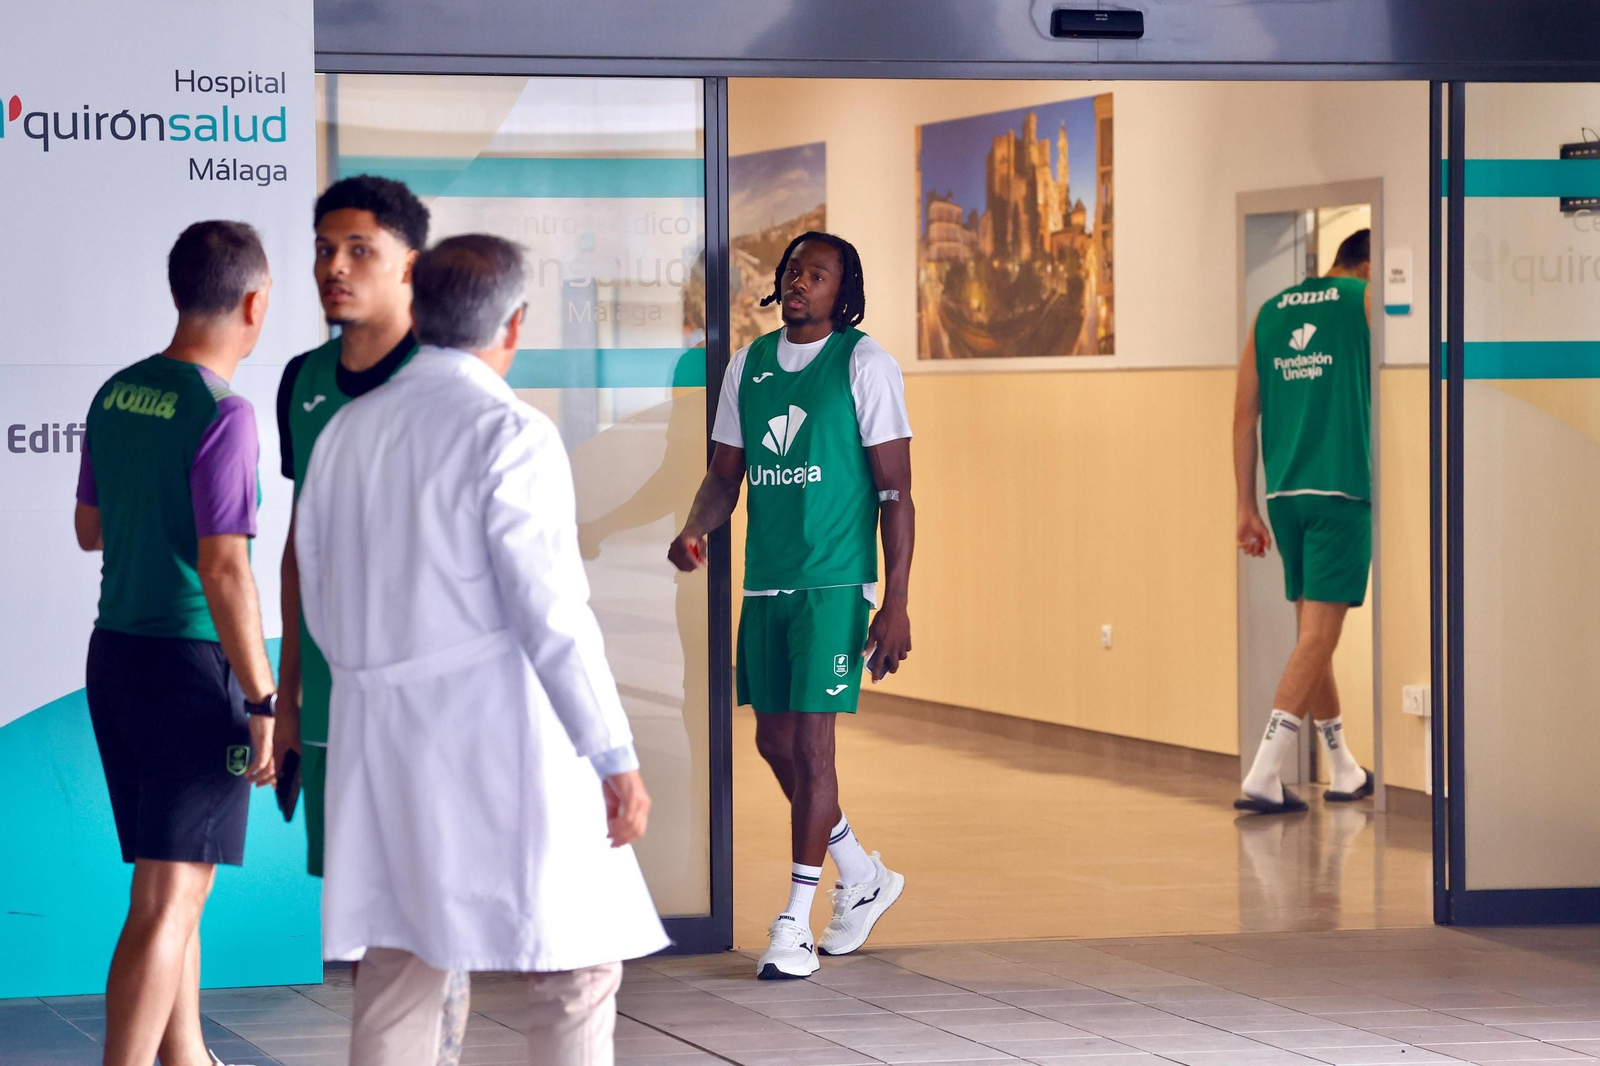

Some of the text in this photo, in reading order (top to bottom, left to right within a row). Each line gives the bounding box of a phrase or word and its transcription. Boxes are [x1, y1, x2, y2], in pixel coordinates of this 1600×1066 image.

[174, 69, 286, 99] Hospital
[23, 104, 287, 152] quirónsalud
[189, 157, 288, 187] Málaga
[1273, 351, 1333, 370] Fundación
[1282, 364, 1323, 381] Unicaja
[749, 461, 822, 489] Unicaja
